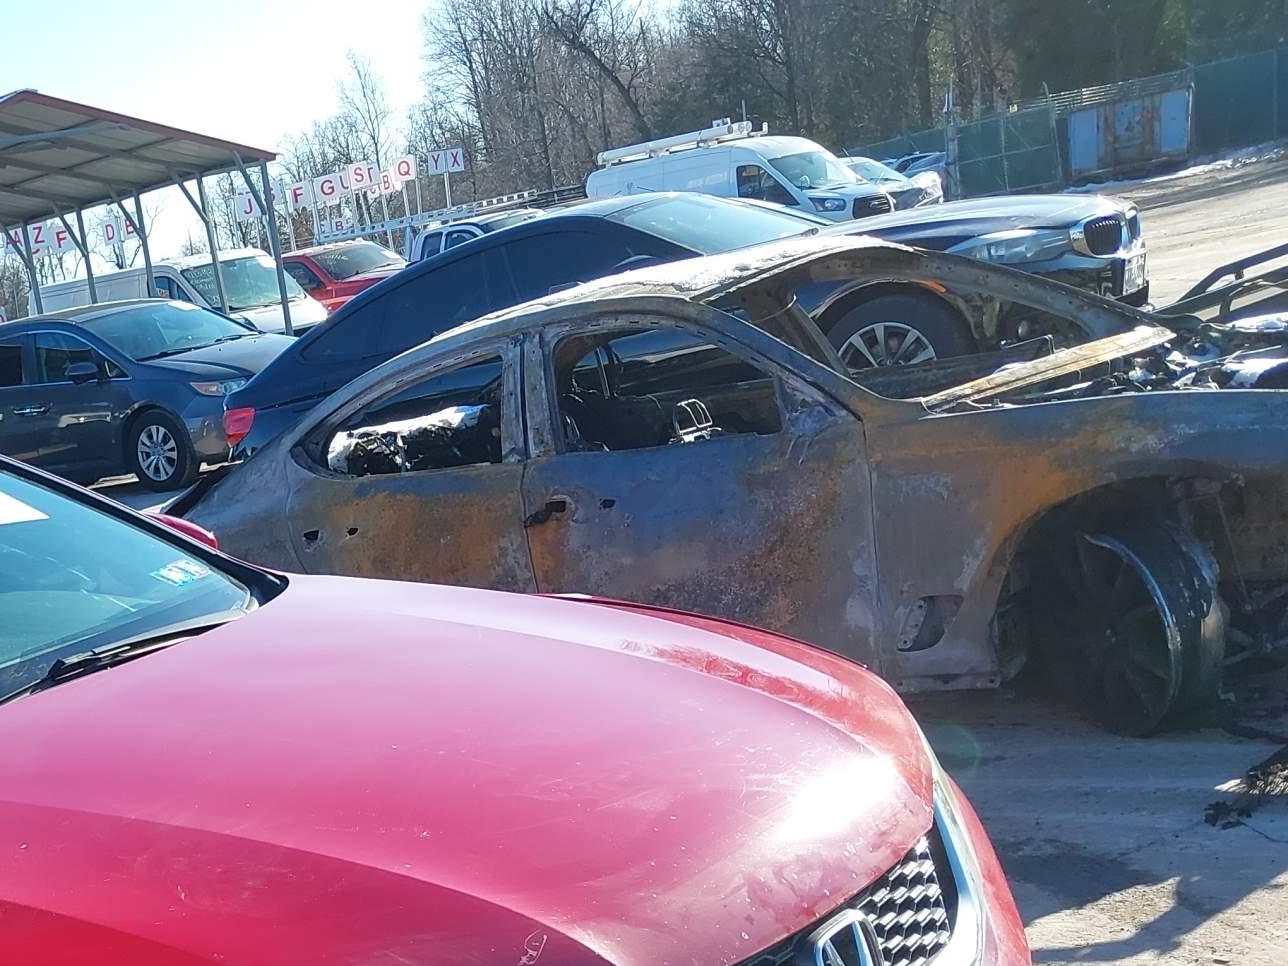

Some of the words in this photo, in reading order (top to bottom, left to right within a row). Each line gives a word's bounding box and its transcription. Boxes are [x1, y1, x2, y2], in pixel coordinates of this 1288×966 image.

[397, 160, 411, 176] Q
[432, 153, 441, 170] Y
[450, 151, 460, 168] X
[353, 166, 364, 183] S
[382, 174, 390, 190] B
[293, 186, 303, 203] F
[320, 179, 335, 196] G
[244, 198, 253, 215] J
[104, 223, 115, 241] D
[335, 220, 344, 231] B
[32, 226, 45, 244] Z
[55, 230, 67, 248] F
